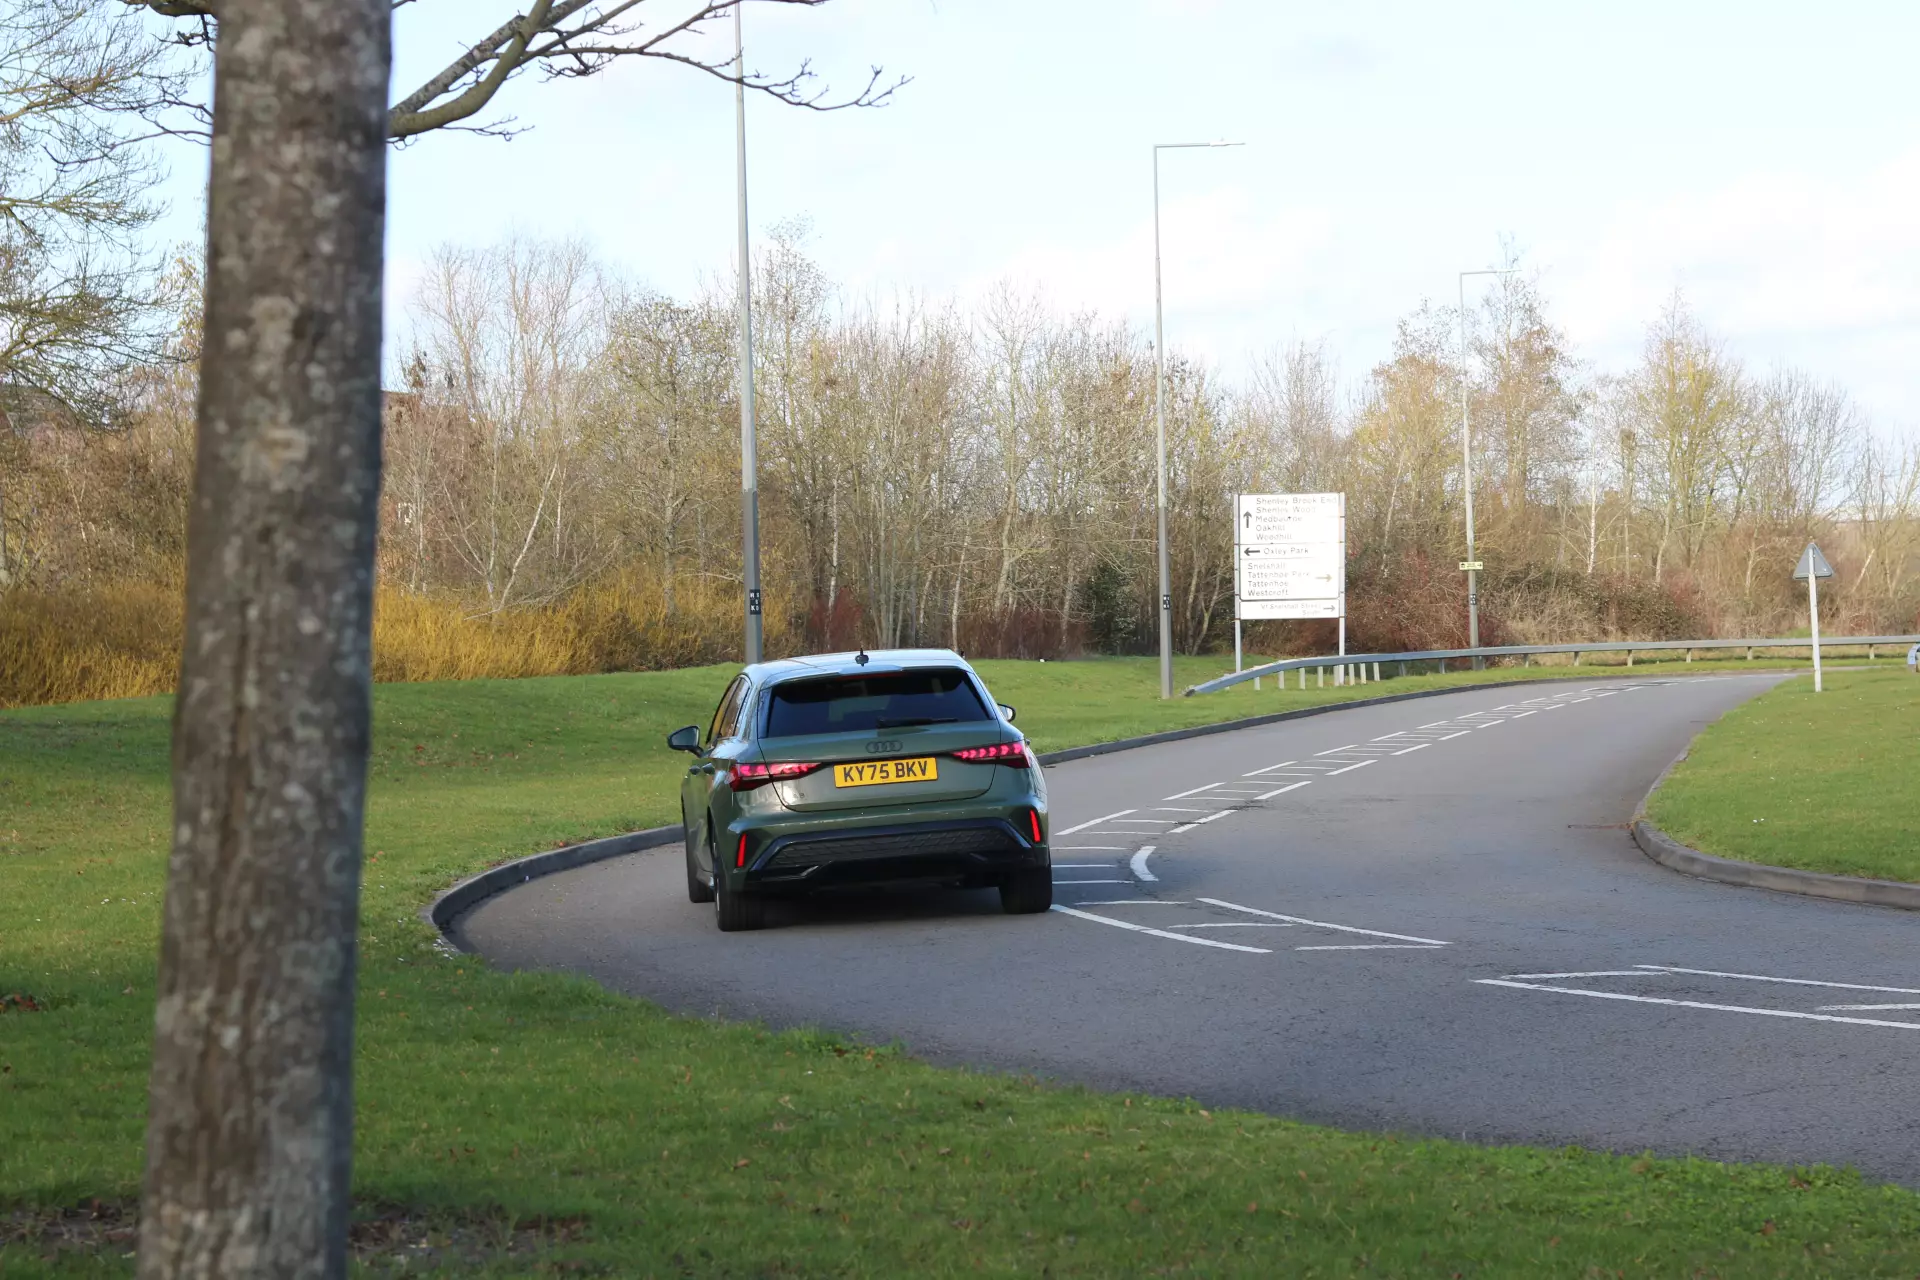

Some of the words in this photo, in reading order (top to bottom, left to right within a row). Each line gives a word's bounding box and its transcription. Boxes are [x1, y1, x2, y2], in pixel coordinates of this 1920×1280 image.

[1256, 497, 1289, 505] Shenley
[1292, 496, 1317, 504] Brook
[1320, 496, 1337, 504] End
[1255, 515, 1304, 523] Medbourne
[1255, 524, 1286, 532] Oakhill
[1256, 533, 1293, 541] Woodhill
[1263, 547, 1287, 555] Oxley
[1247, 562, 1286, 570] Snelshall
[1247, 570, 1289, 579] Tattenhoe
[1247, 580, 1289, 588] Tattenhoe
[1247, 589, 1289, 597] Westcroft
[843, 763, 890, 783] KY75
[894, 760, 928, 778] BKV
